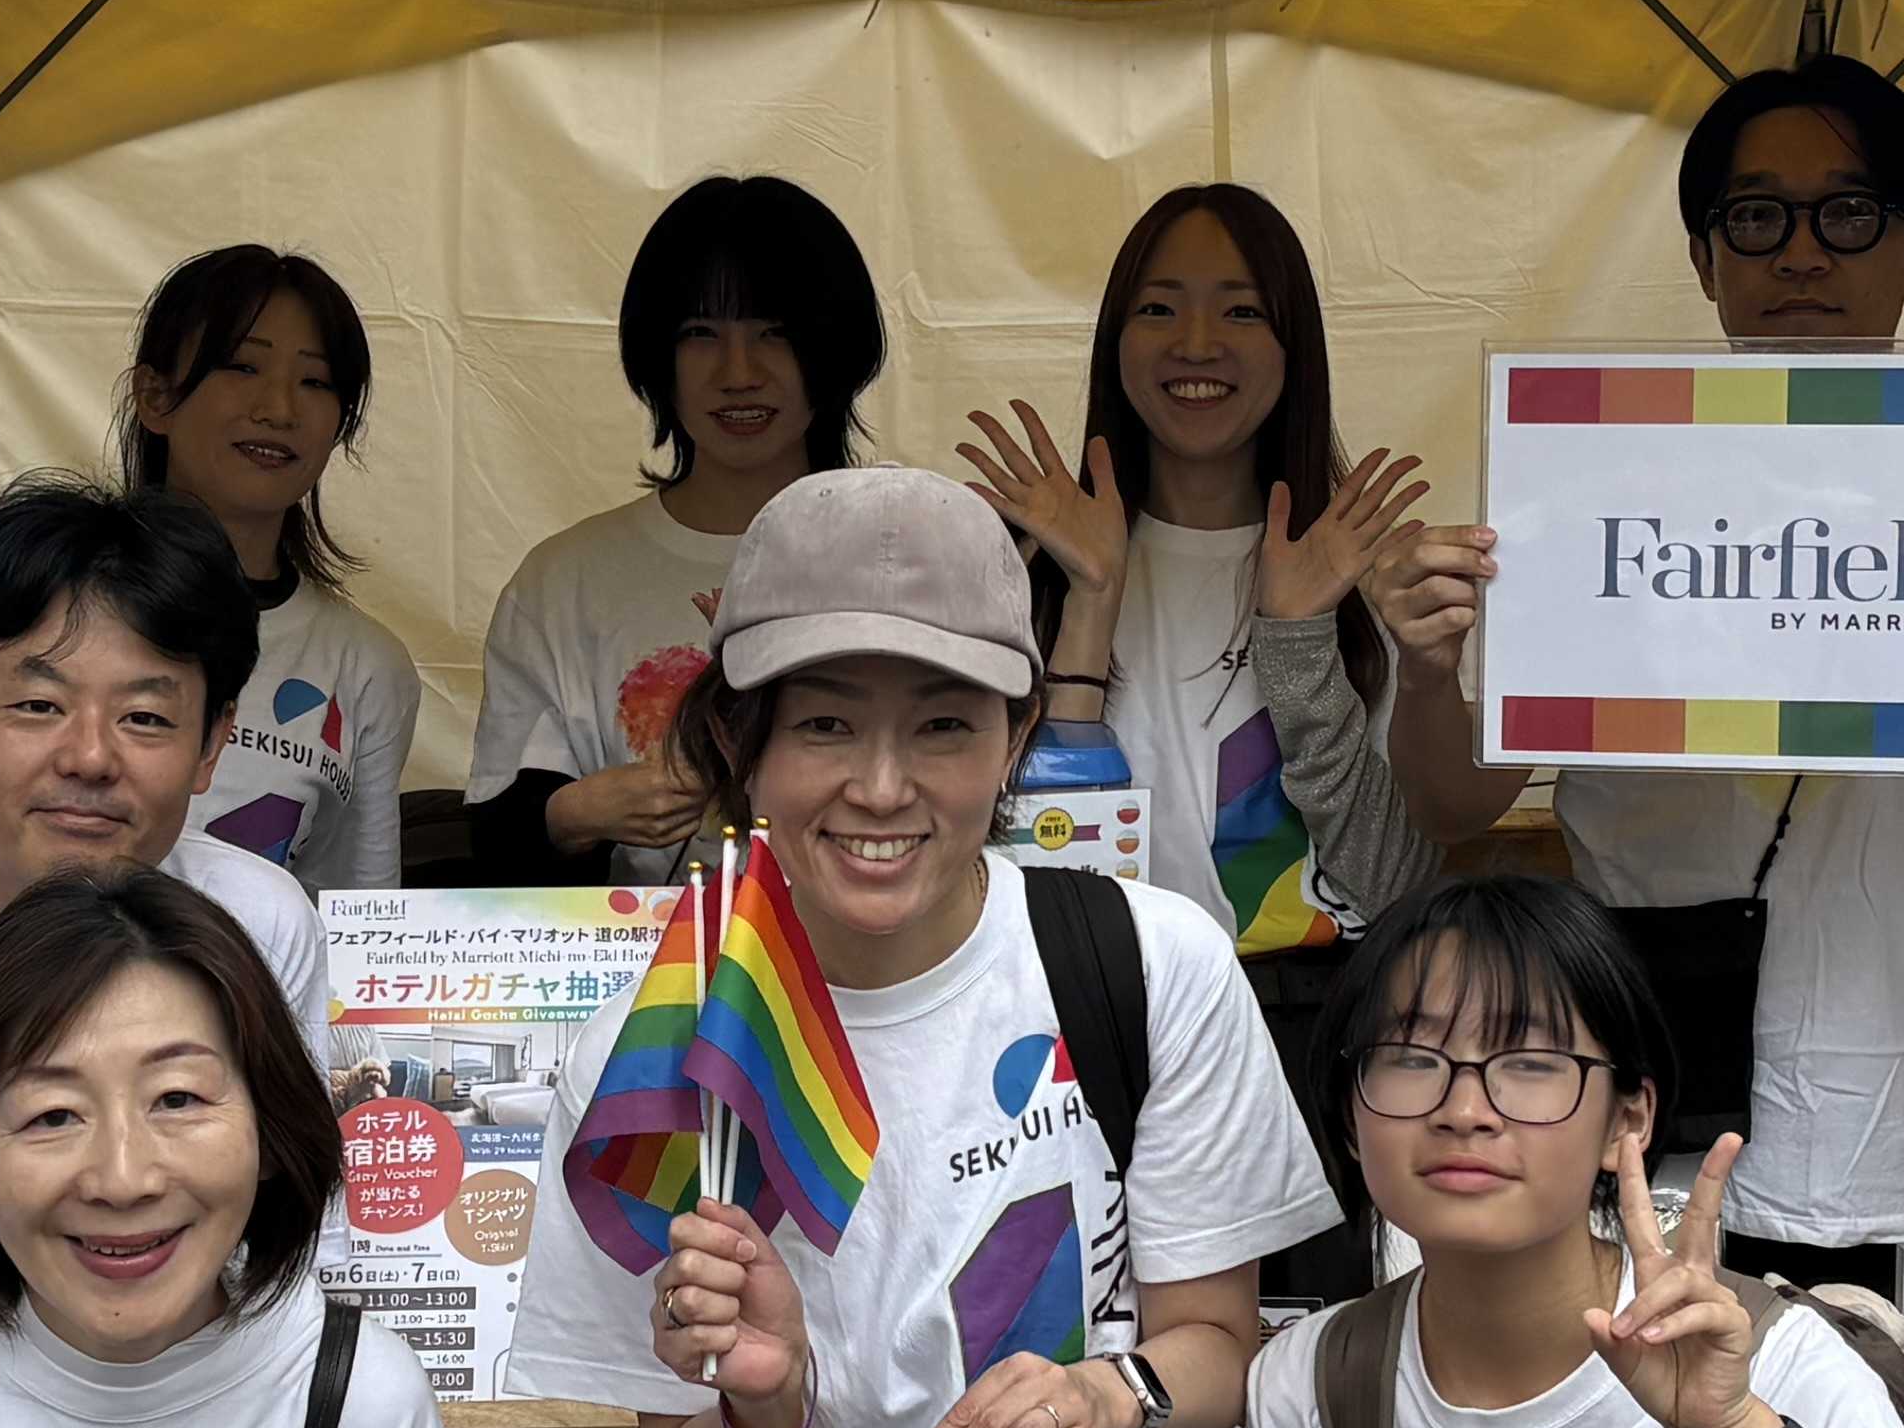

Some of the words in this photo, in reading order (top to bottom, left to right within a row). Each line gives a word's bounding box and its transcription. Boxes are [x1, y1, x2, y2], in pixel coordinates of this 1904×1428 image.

[1771, 613, 1808, 631] BY
[356, 1110, 428, 1133] ホテル
[344, 1136, 438, 1167] 宿泊券
[360, 1186, 421, 1202] が当たる
[464, 1205, 526, 1225] Tシャツ
